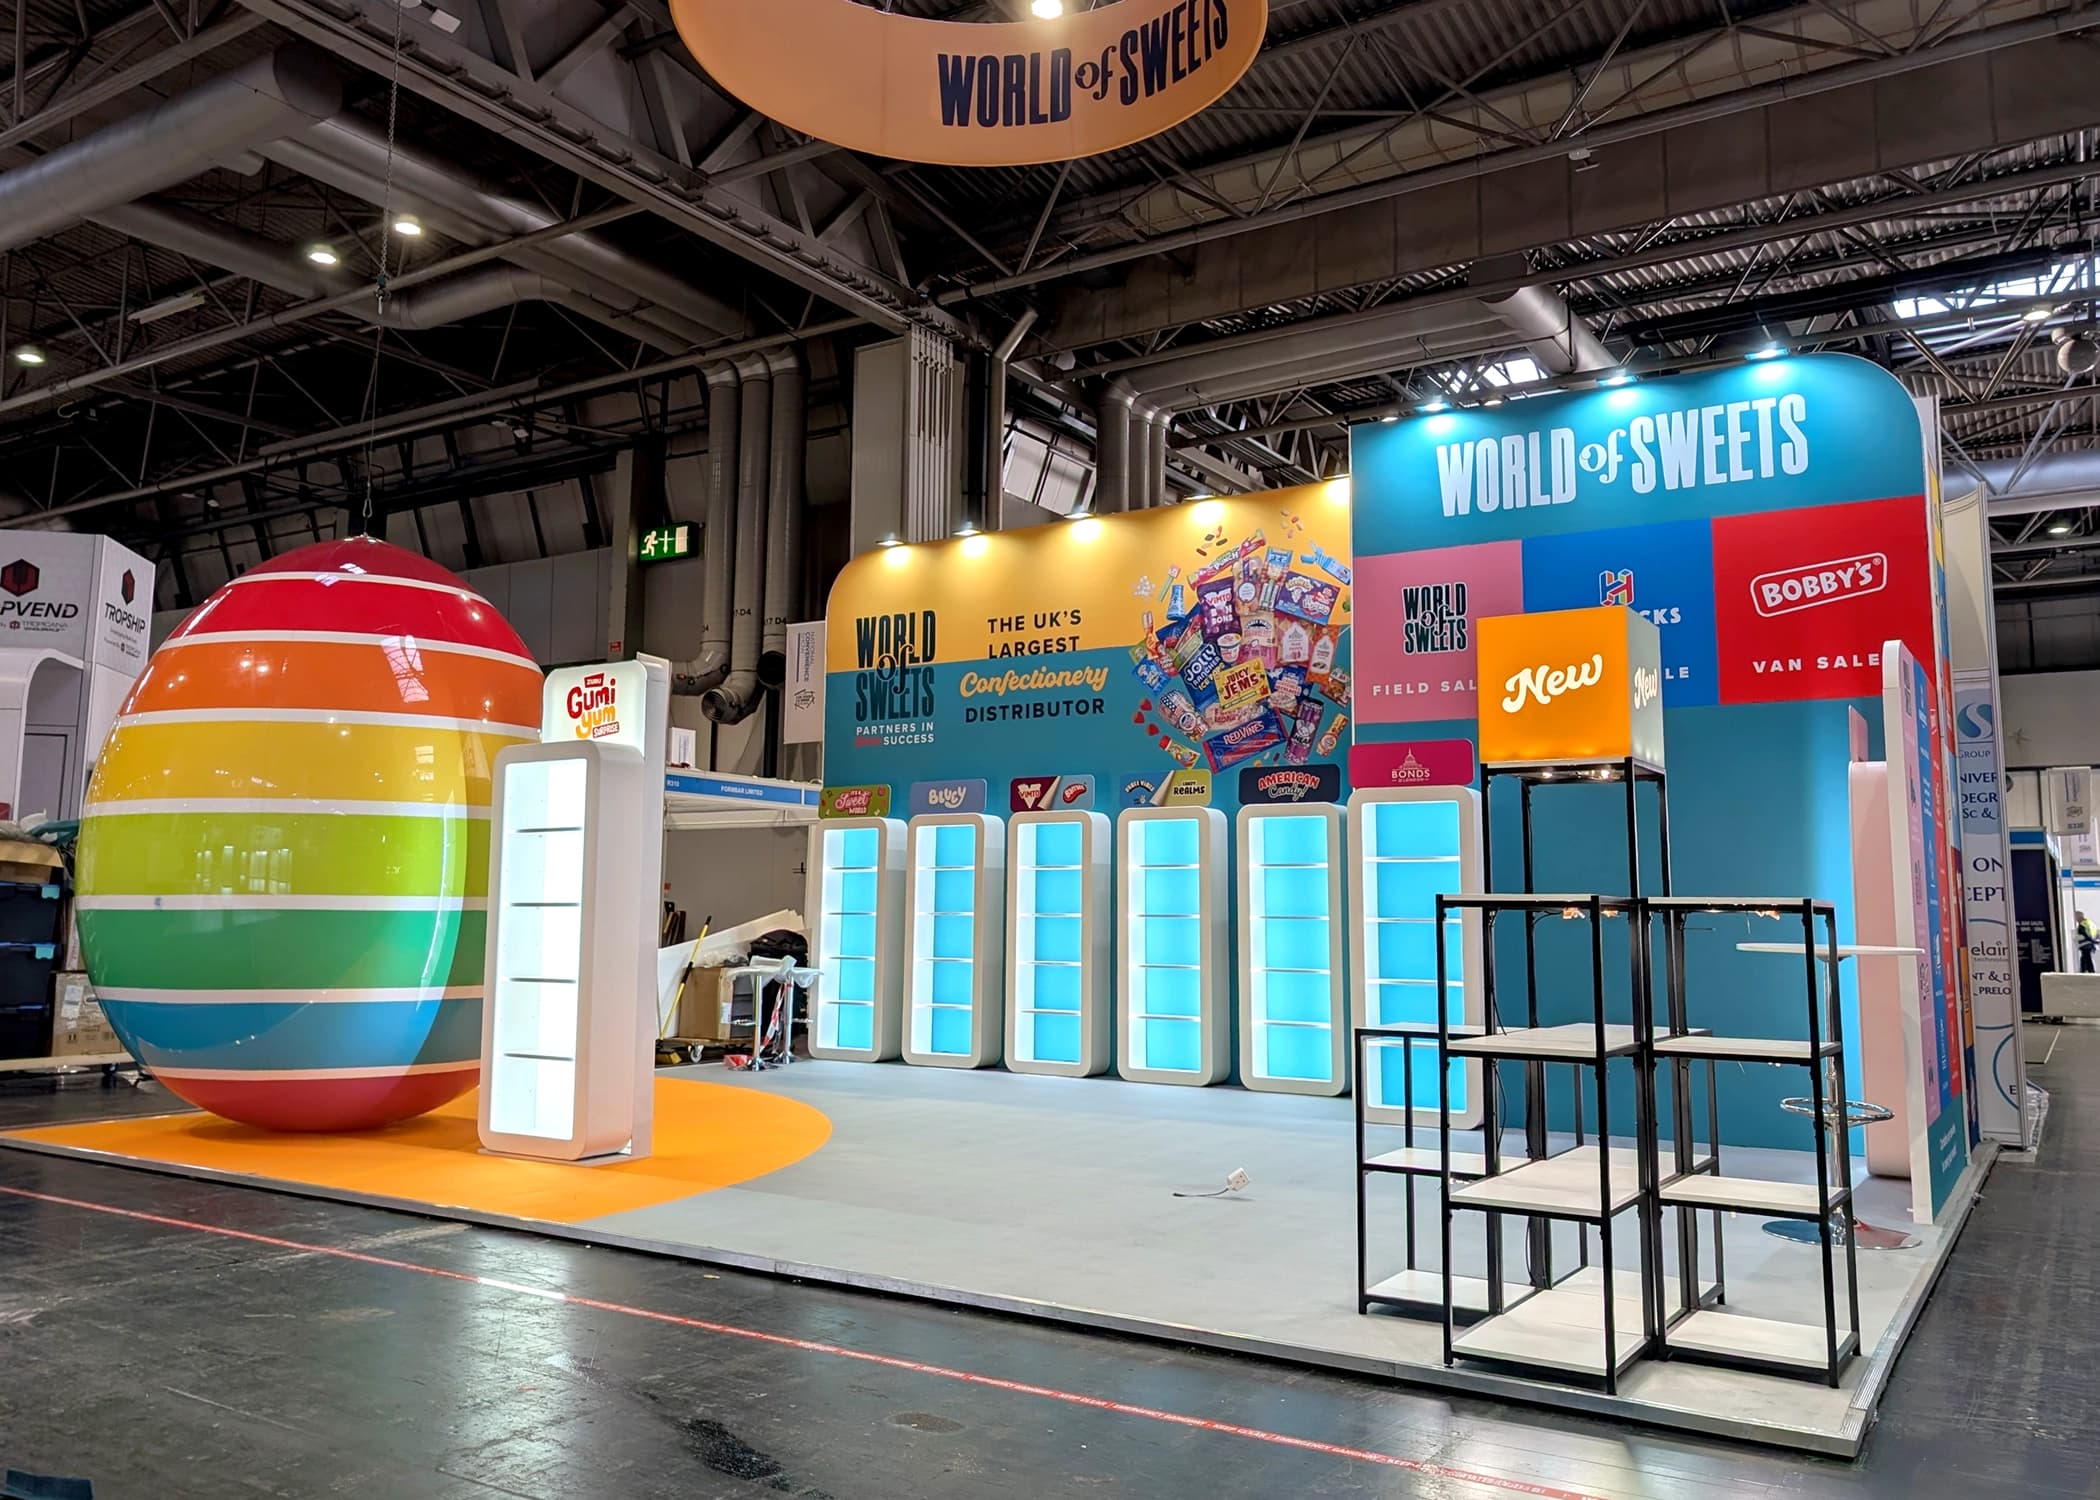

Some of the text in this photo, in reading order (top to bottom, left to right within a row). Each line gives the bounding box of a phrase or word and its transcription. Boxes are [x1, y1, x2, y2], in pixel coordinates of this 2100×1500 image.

[937, 0, 1228, 127] WORLD of SWEETS
[1436, 394, 1809, 517] WORLD of SWEETS
[1761, 562, 1874, 608] BOBBY'S
[0, 600, 79, 618] PVEND
[1402, 582, 1467, 621] WORLD
[104, 602, 146, 634] TROPSHIP
[988, 609, 1082, 633] THE UK'S
[1420, 604, 1449, 636] of
[856, 610, 936, 668] WORLD
[988, 635, 1081, 660] LARGEST
[1404, 620, 1467, 655] SWEETS
[876, 644, 914, 694] of
[1186, 643, 1217, 682] JOLLY
[1225, 666, 1249, 684] JUICY
[1753, 653, 1879, 673] VAN SALE
[855, 666, 935, 722] SWEETS
[959, 665, 1109, 698] Confectionery
[1223, 672, 1259, 700] JEMS
[1373, 683, 1429, 696] FIELD
[1501, 654, 1603, 713] New
[1634, 667, 1658, 710] New
[567, 678, 616, 719] Gumi
[965, 698, 1105, 723] DISTRIBUTOR
[576, 705, 616, 739] yum
[856, 722, 934, 736] PARTNERS IN
[883, 734, 935, 746] SUCCESS
[1258, 771, 1320, 791] AMERICAN
[1391, 769, 1430, 779] BONDS
[1967, 886, 2005, 902] EPT
